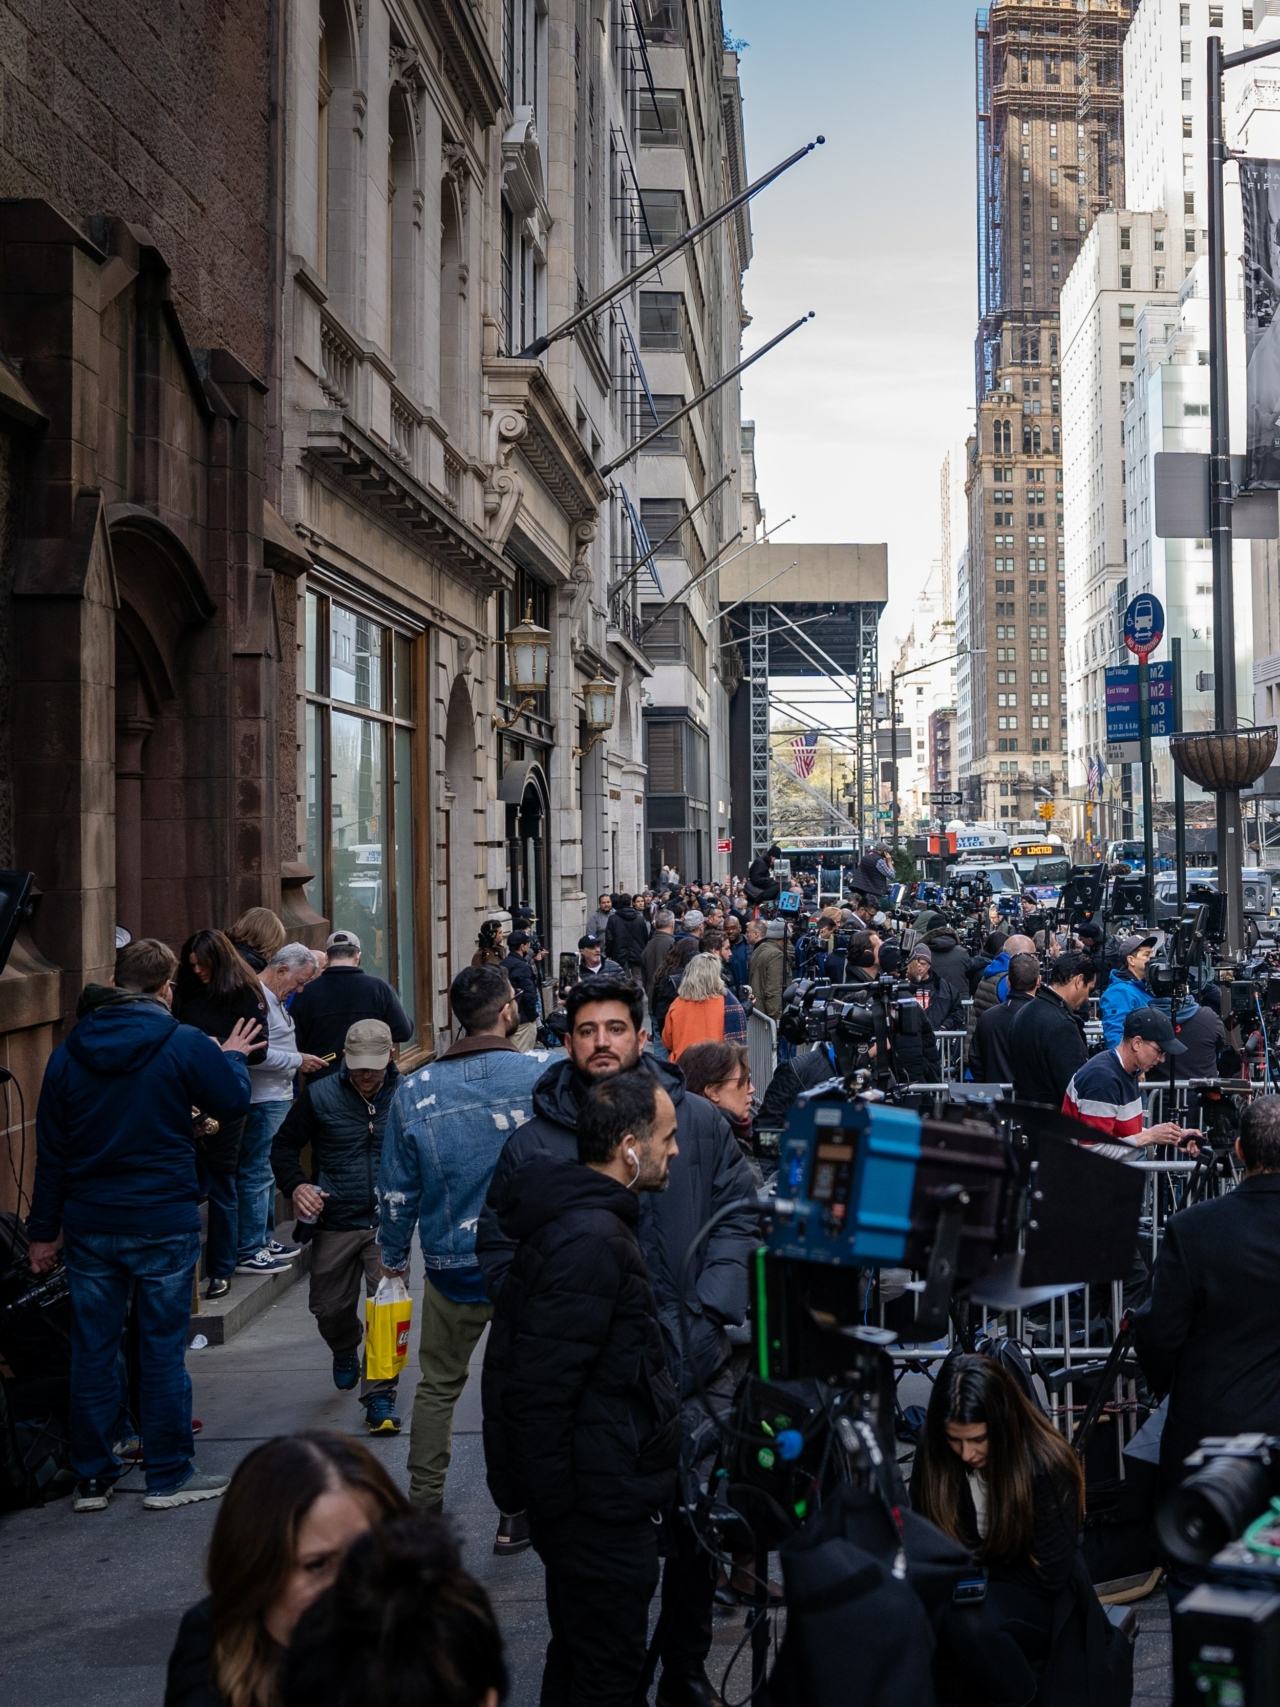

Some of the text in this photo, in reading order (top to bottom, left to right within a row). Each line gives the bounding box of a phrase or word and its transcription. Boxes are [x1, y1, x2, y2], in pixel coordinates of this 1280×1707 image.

[1247, 171, 1259, 179] IT
[1126, 636, 1160, 652] NO STANDING
[1150, 664, 1164, 679] M2
[1151, 683, 1165, 697] M2
[1151, 702, 1166, 716] M3
[1152, 720, 1166, 734] M5
[1027, 846, 1053, 855] LIMITED
